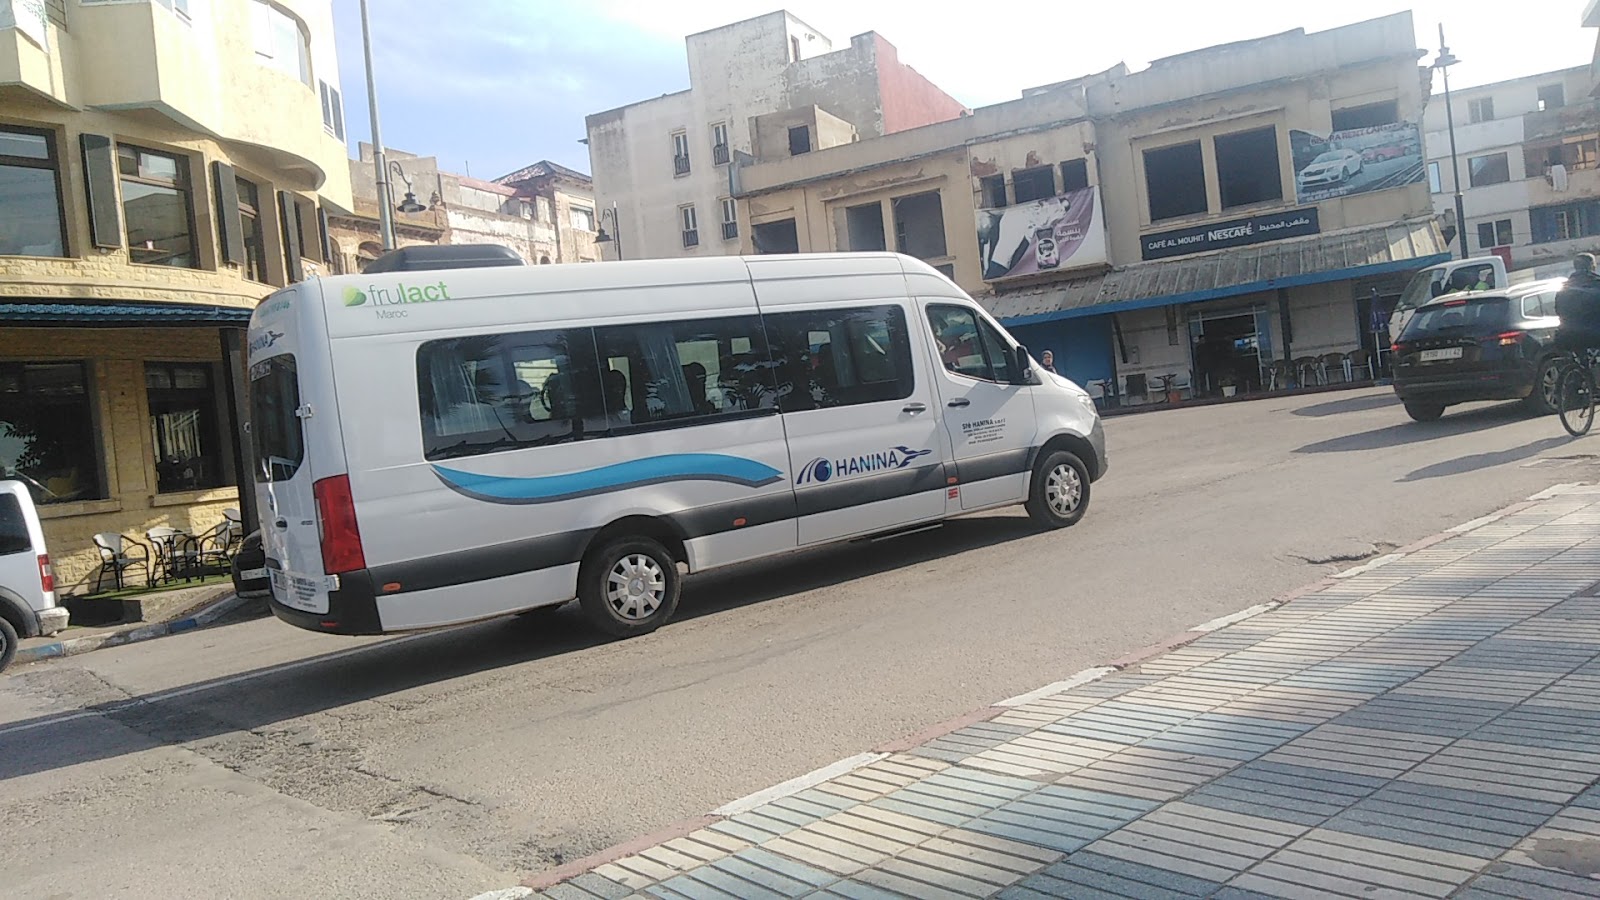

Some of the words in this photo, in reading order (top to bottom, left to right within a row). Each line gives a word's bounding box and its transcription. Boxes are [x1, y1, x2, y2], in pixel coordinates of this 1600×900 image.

[1259, 221, 1285, 232] المحيط
[1148, 238, 1166, 250] CAFÉ
[1167, 238, 1177, 247] AL
[1178, 234, 1205, 245] MOUHIT
[368, 281, 450, 306] frulact
[376, 309, 408, 319] Maroc
[972, 419, 994, 428] HANINA
[836, 450, 899, 477] HANINA
